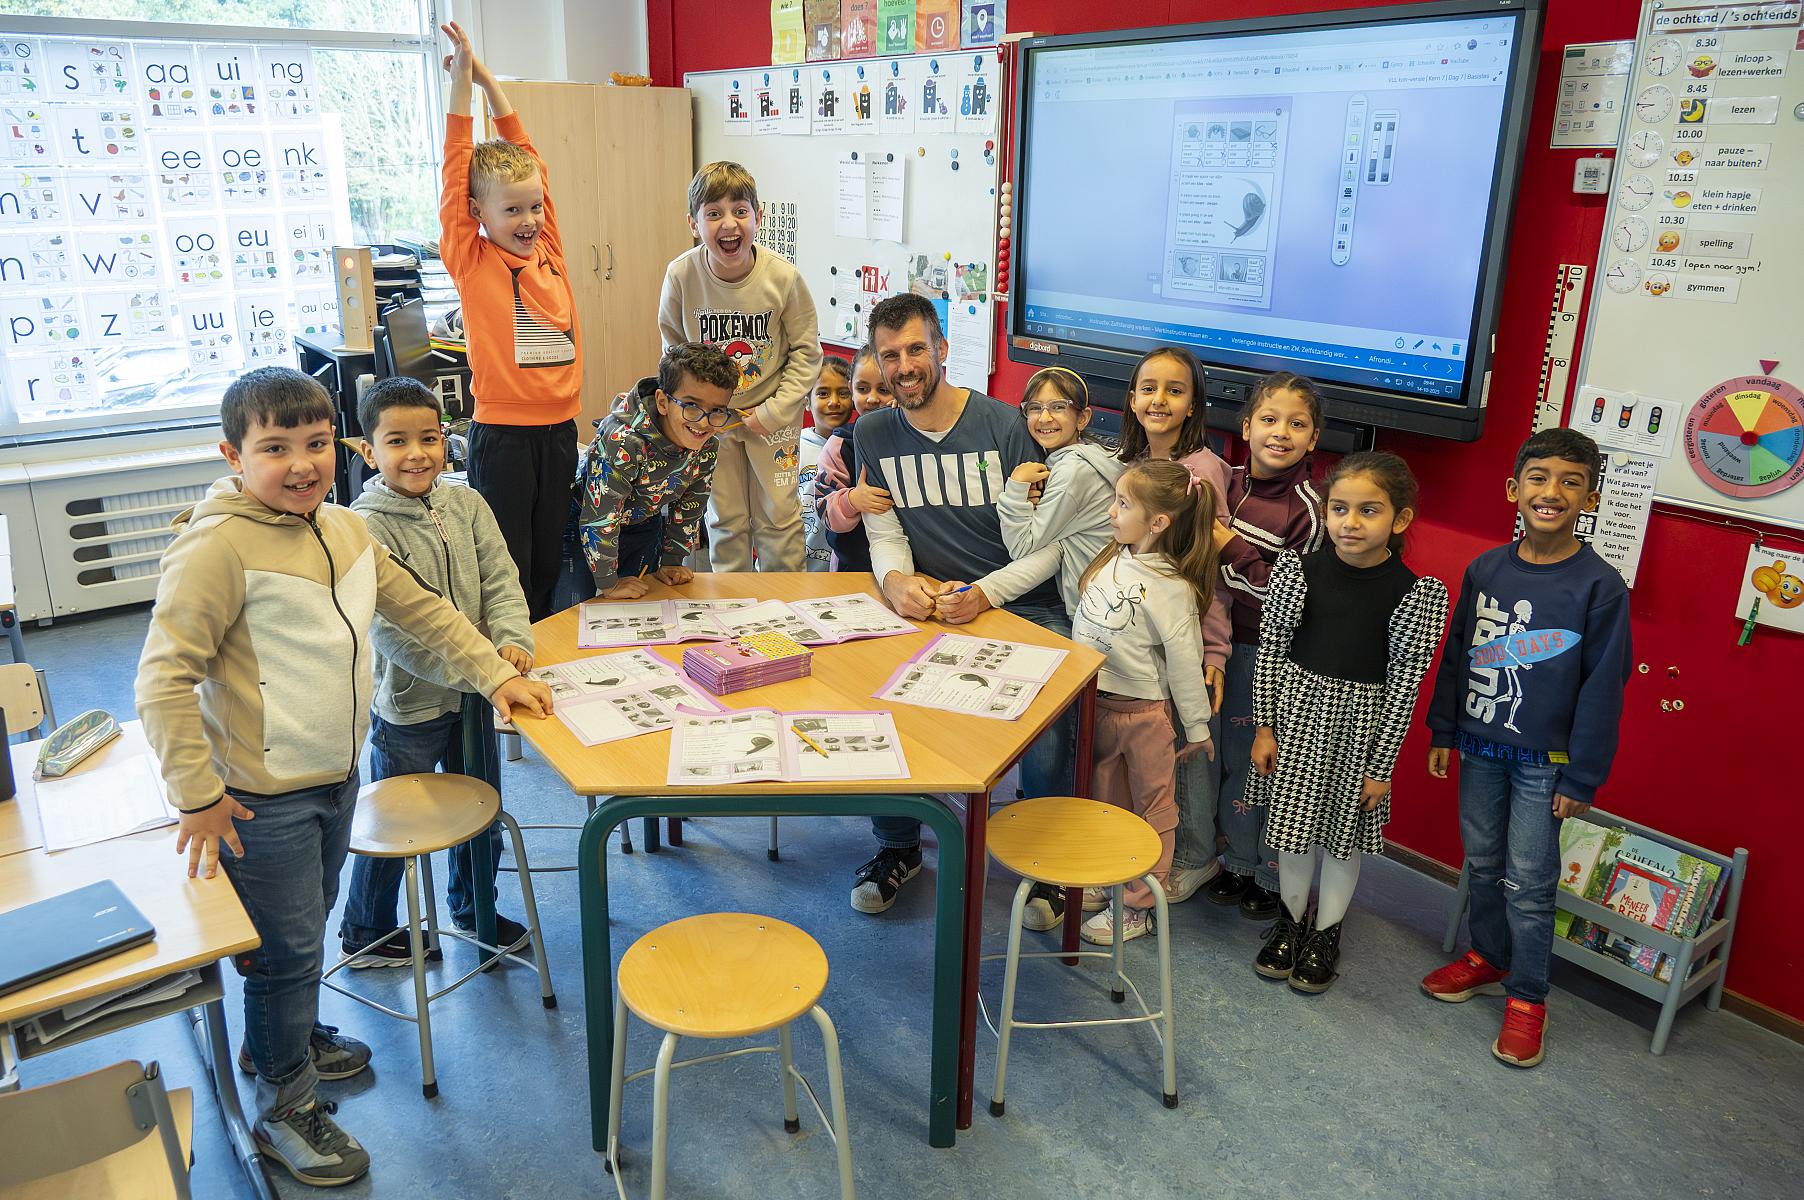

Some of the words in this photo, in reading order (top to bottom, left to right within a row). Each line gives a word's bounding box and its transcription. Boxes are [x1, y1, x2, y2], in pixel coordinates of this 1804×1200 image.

[1656, 16, 1669, 24] de
[1673, 13, 1718, 24] ochtend
[1743, 10, 1798, 21] ochtends
[1696, 38, 1717, 48] 8.30
[1735, 54, 1764, 64] inloop
[146, 64, 189, 84] aa
[217, 57, 240, 81] ui
[271, 62, 304, 83] ng
[1718, 67, 1782, 77] lezen+werken
[63, 65, 80, 90] s
[1687, 84, 1707, 94] 8.45
[1732, 105, 1755, 114] lezen
[72, 128, 90, 154] t
[1677, 130, 1703, 139] 10.00
[223, 149, 261, 167] oe
[284, 142, 317, 166] nk
[1718, 147, 1745, 156] pauze
[161, 150, 201, 169] ee
[1705, 160, 1725, 168] naar
[1727, 158, 1762, 168] buiten?
[1668, 173, 1694, 182] 10.15
[1702, 190, 1723, 199] klein
[1726, 191, 1751, 201] hapje
[80, 193, 101, 215] v
[772, 203, 775, 214] 8
[781, 203, 785, 214] 9
[788, 203, 794, 215] 10
[1692, 203, 1712, 211] eten
[1722, 202, 1756, 212] drinken
[769, 216, 776, 228] 18
[778, 216, 785, 228] 19
[788, 217, 795, 229] 20
[1659, 216, 1685, 225] 10.30
[238, 228, 269, 247] eu
[294, 225, 307, 238] ei
[318, 224, 325, 240] ij
[760, 229, 766, 240] 27
[769, 229, 775, 241] 28
[778, 230, 785, 241] 29
[787, 231, 794, 242] 30
[176, 233, 214, 252] oo
[778, 242, 785, 254] 39
[787, 244, 794, 256] 40
[1700, 239, 1734, 249] spelling
[83, 253, 116, 274] w
[1651, 258, 1676, 267] 10.45
[1685, 259, 1710, 270] lopen
[1687, 284, 1725, 292] gymmen
[302, 305, 317, 313] au
[323, 302, 337, 310] ou
[193, 311, 224, 330] uu
[251, 304, 274, 327] ie
[10, 316, 34, 343] p
[1231, 337, 1256, 346] Verlengde
[1257, 341, 1282, 349] instructie
[1302, 346, 1332, 357] Zelfstandig
[28, 378, 40, 401] r
[1746, 378, 1781, 390] vandaag
[1700, 385, 1726, 409] gisteren
[1704, 402, 1724, 427] maandag
[1772, 399, 1797, 423] woensdag
[1686, 418, 1696, 459] eergisteren
[1787, 429, 1799, 461] donderdag
[1701, 439, 1710, 459] zondag
[1718, 442, 1741, 463] weekend
[1716, 468, 1744, 481] zaterdag
[1759, 469, 1781, 481] vrijdag
[1621, 490, 1643, 498] leren?
[1613, 532, 1637, 540] samen.
[1605, 552, 1624, 560] werk!
[1474, 644, 1506, 666] GOOD
[1516, 632, 1564, 657] DAYS
[1466, 591, 1509, 724] SURF
